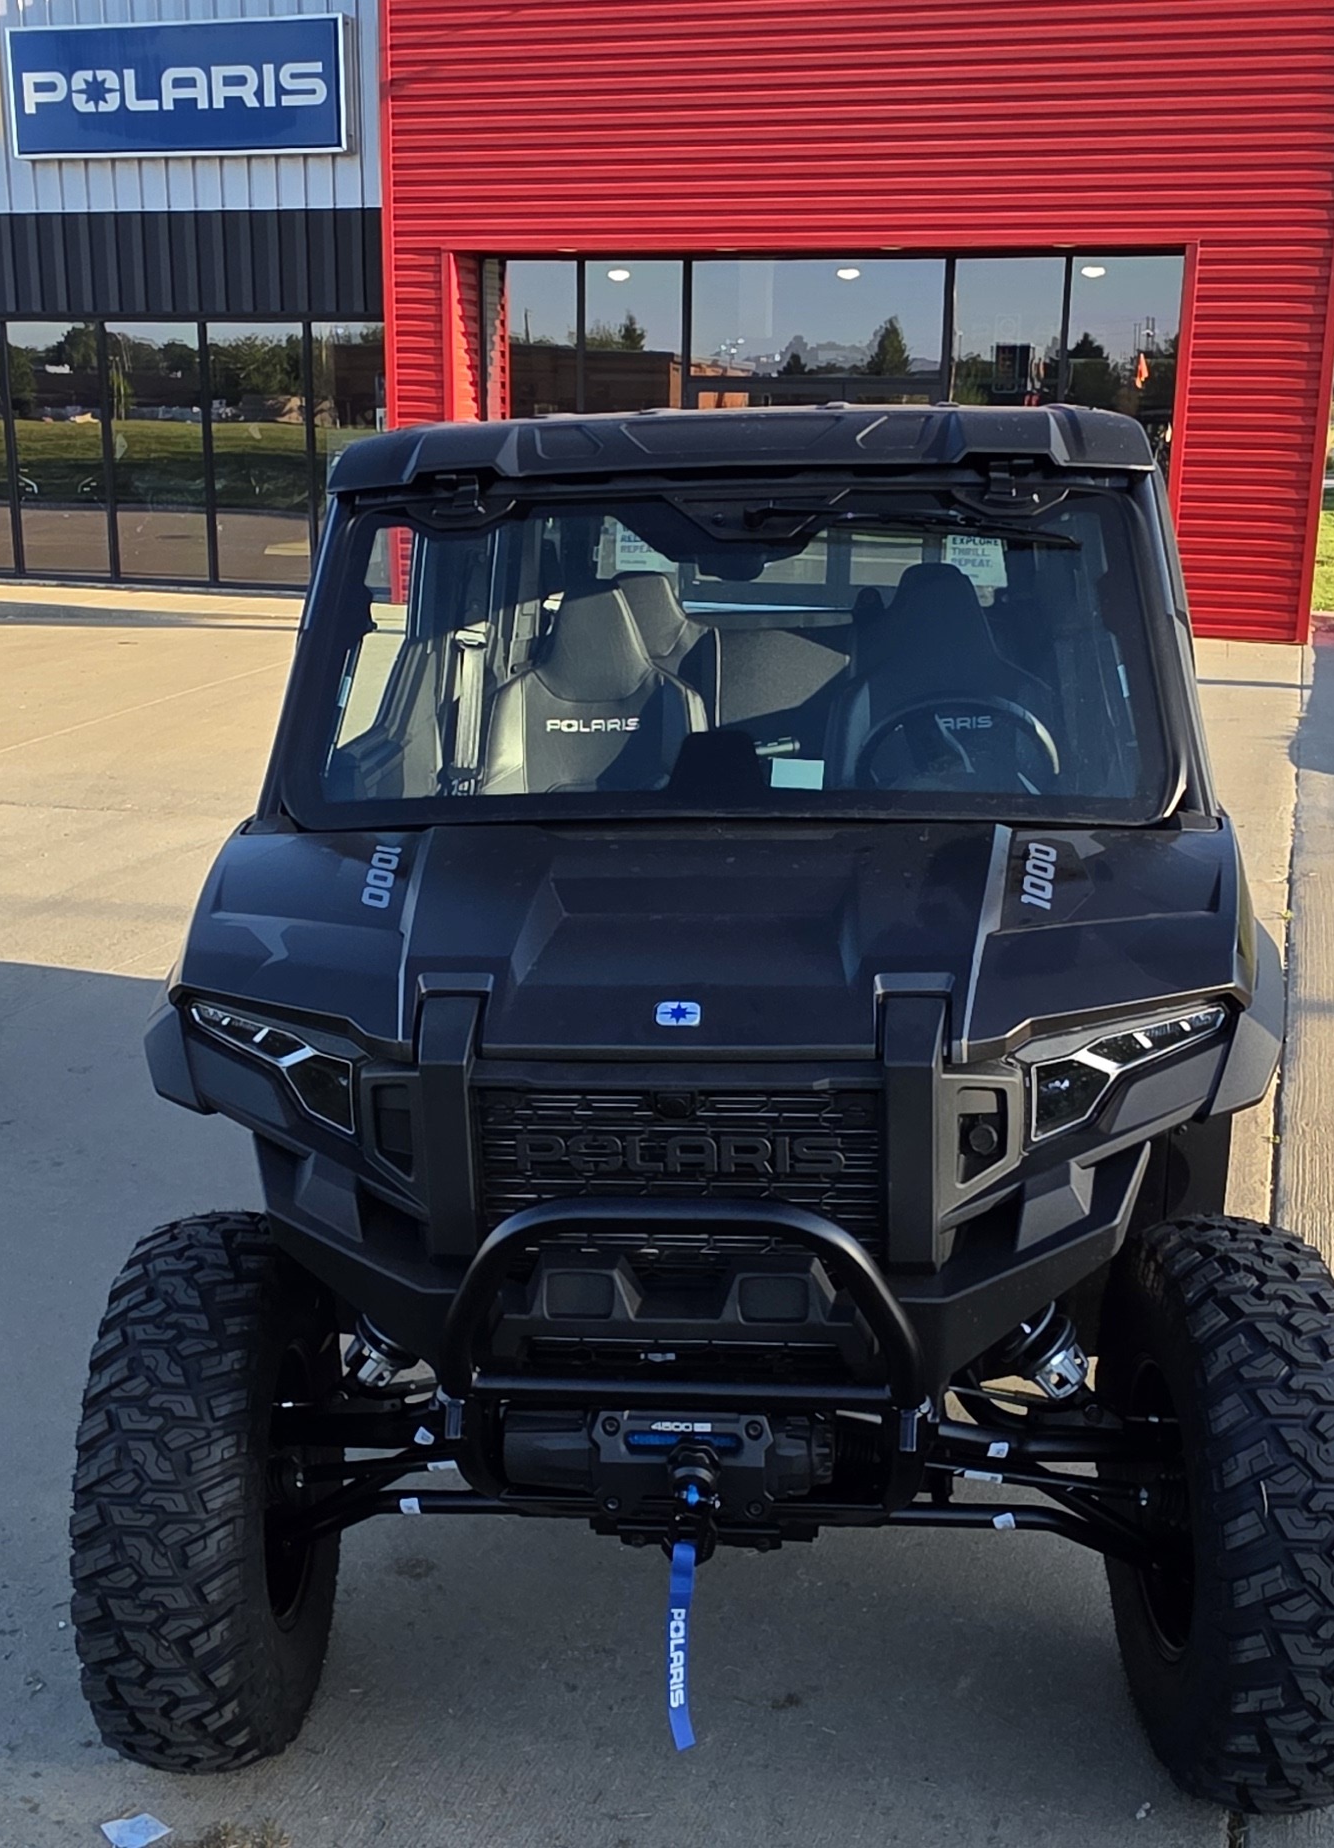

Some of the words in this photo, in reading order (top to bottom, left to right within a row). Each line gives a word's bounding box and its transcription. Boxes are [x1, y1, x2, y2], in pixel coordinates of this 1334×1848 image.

[22, 61, 327, 115] POLARIS
[546, 718, 640, 732] POLARIS
[937, 716, 993, 730] ARIS
[361, 845, 402, 909] 1000
[1020, 842, 1057, 911] 1000
[517, 1135, 845, 1173] POLARIS
[670, 1608, 686, 1708] POLARIS
